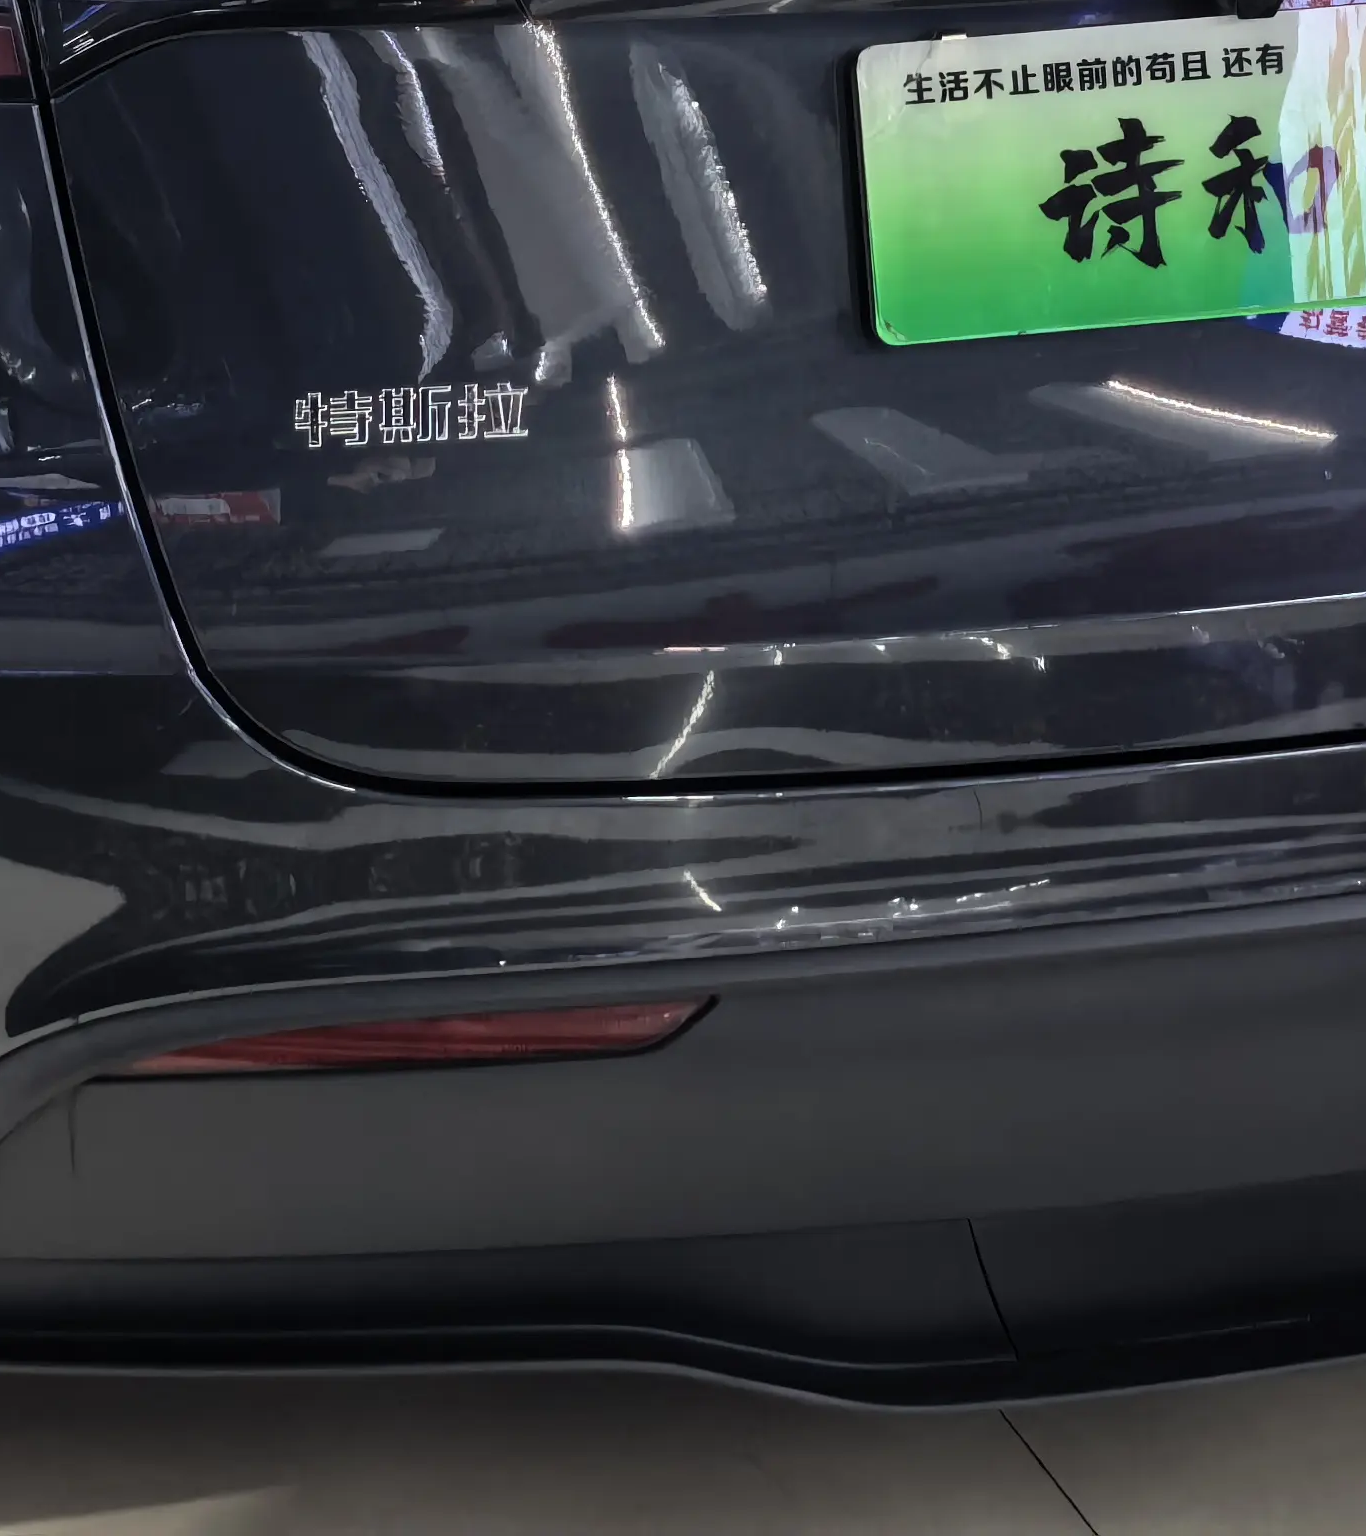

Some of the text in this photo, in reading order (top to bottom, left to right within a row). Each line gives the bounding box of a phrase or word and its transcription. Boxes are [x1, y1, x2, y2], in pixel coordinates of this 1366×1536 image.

[902, 42, 1286, 106] 生活不止眼前的苟且 还有
[294, 381, 529, 448] 特斯拉
